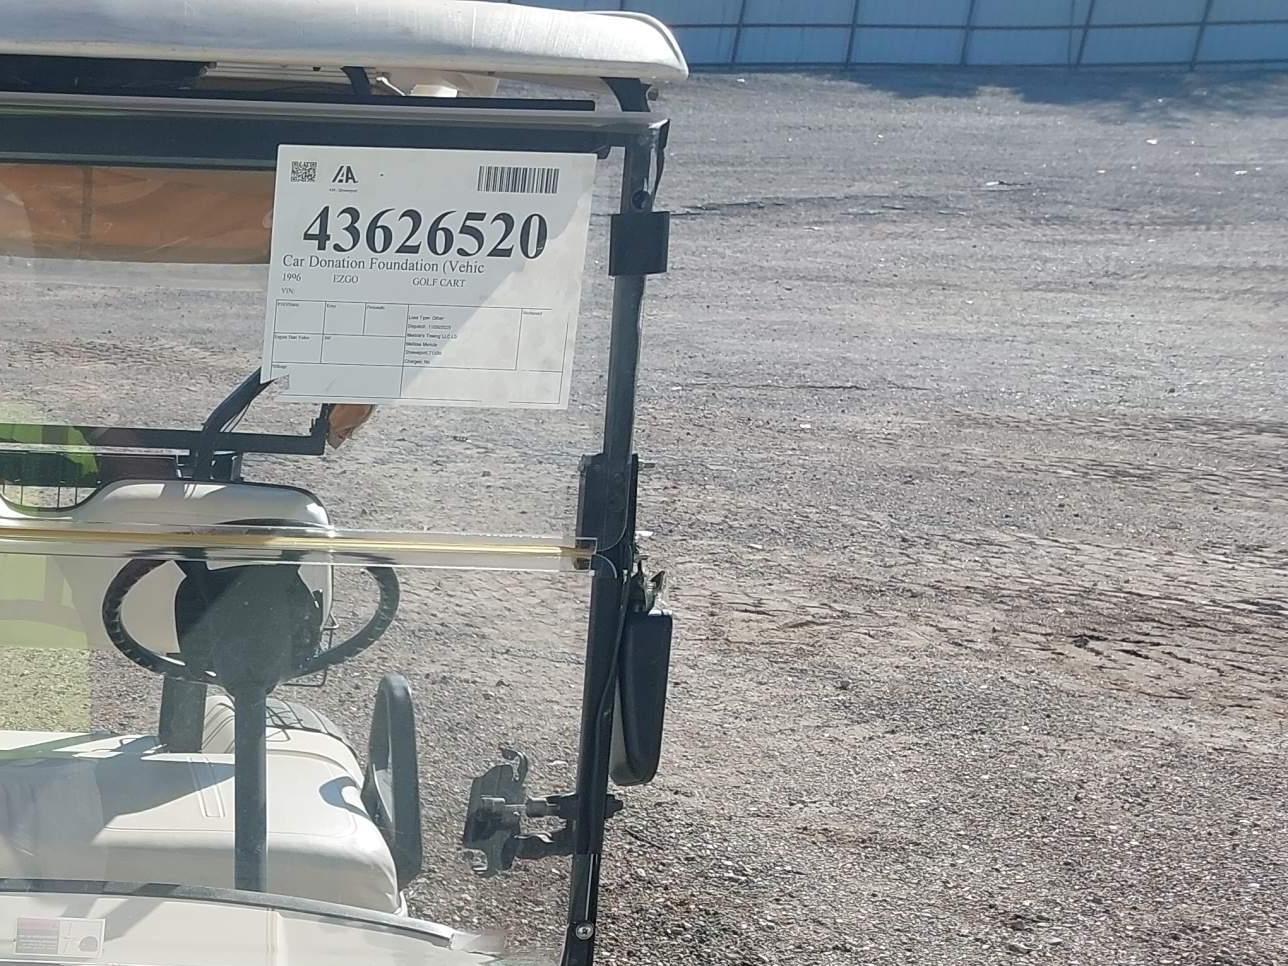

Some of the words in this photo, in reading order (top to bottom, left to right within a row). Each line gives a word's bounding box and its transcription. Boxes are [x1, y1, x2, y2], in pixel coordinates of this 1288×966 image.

[303, 205, 548, 259] 43626520
[282, 254, 305, 267] Car
[309, 255, 365, 269] Donation
[369, 257, 439, 272] Foundation
[442, 259, 485, 275] (Vehic
[281, 271, 302, 282] 1996
[332, 274, 359, 284] EZGO
[412, 277, 438, 287] GOLF
[439, 278, 467, 288] CART
